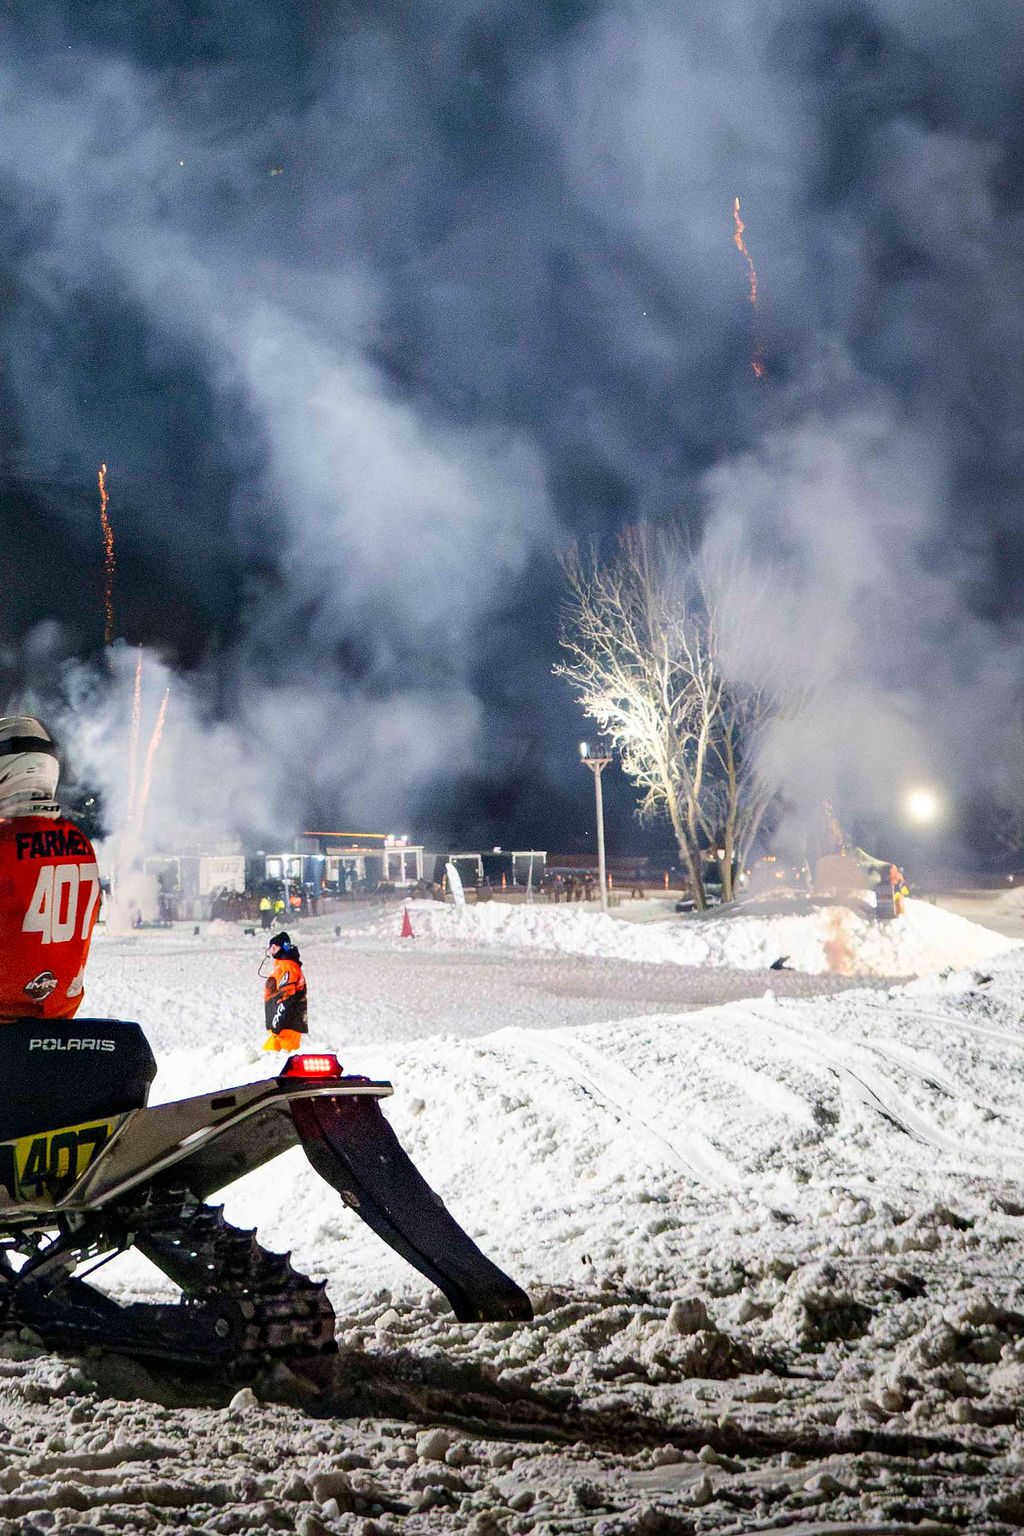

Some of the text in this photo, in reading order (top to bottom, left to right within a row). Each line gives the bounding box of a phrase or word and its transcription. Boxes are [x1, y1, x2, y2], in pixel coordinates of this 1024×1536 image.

[21, 862, 100, 945] 407
[29, 1038, 115, 1052] POLARIS
[21, 1124, 108, 1200] 407
